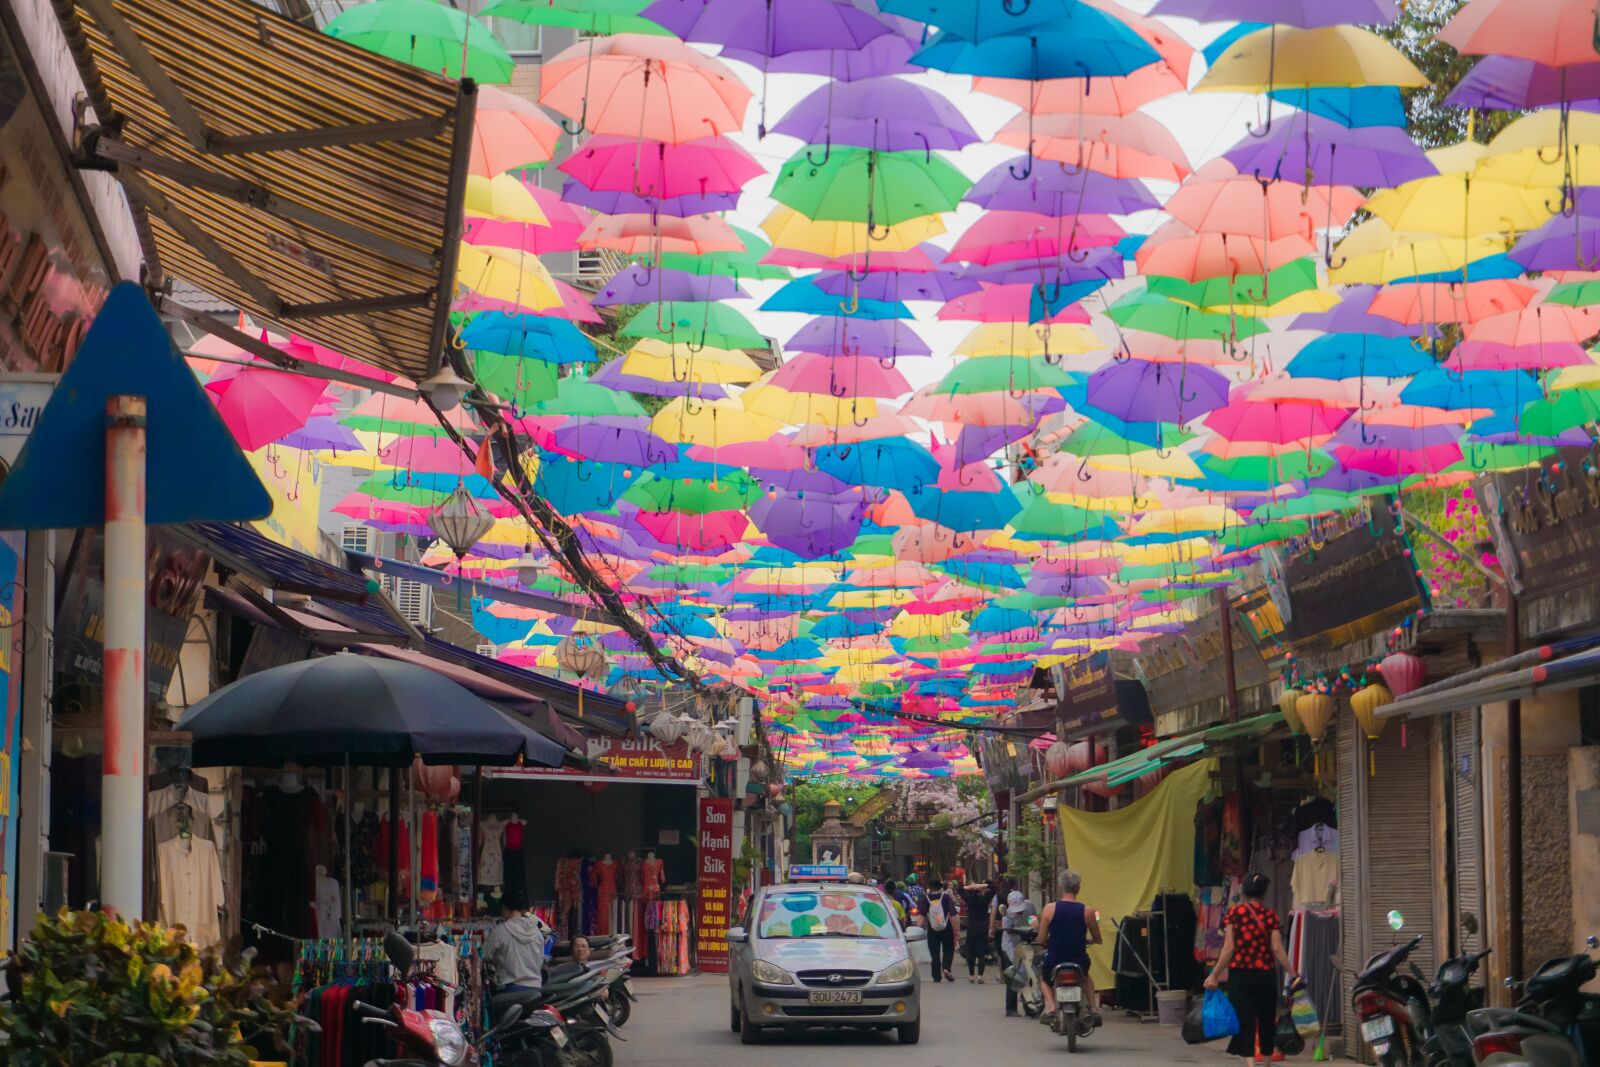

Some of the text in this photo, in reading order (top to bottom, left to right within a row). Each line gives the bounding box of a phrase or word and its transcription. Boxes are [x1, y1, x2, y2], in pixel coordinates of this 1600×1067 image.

[677, 759, 693, 769] CAO
[702, 831, 730, 851] Hạnh
[704, 856, 726, 874] Silk
